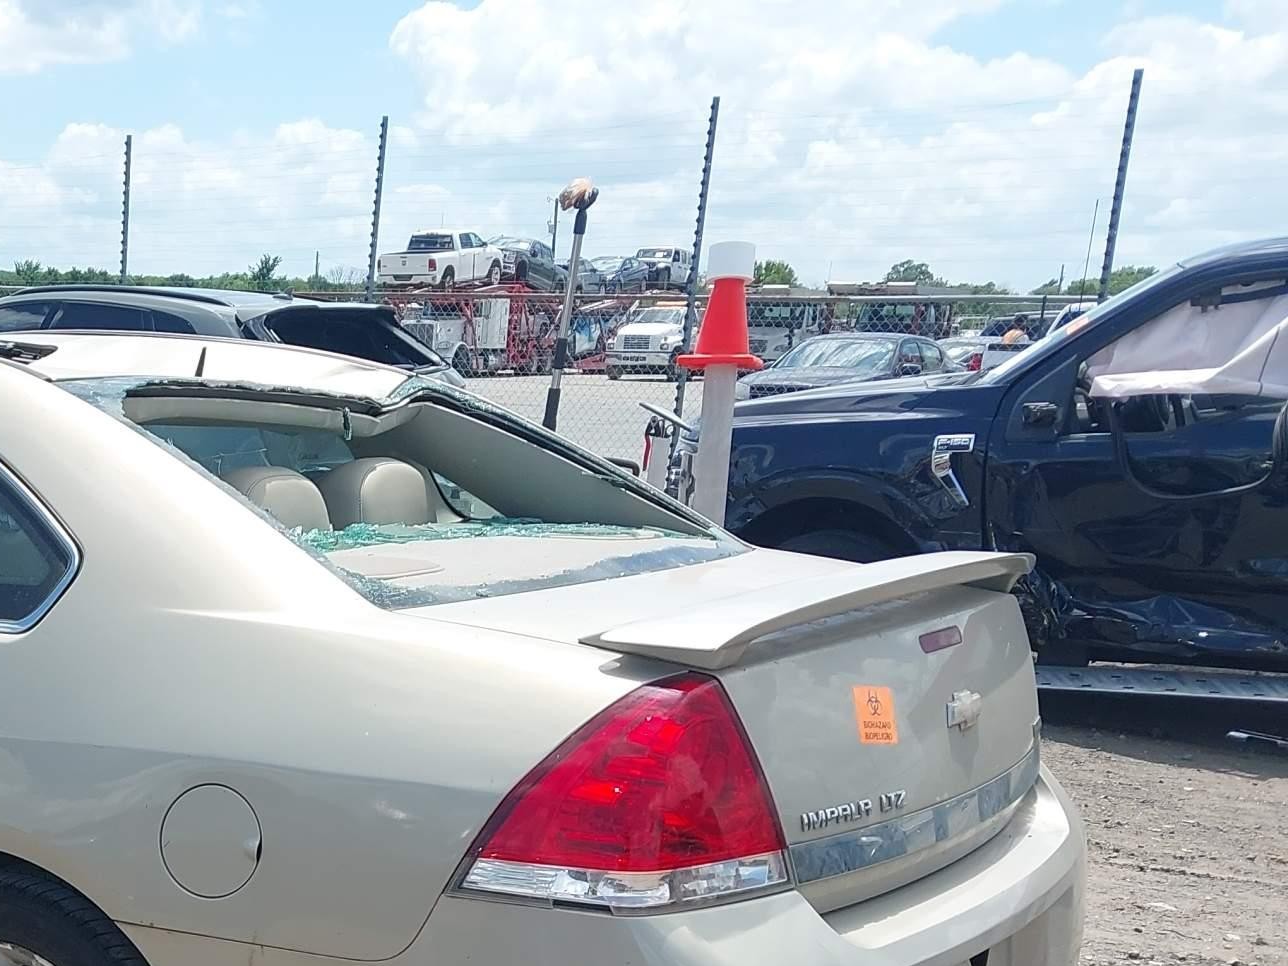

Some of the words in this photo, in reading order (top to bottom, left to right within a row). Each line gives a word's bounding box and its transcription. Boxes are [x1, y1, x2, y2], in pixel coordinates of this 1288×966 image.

[938, 438, 970, 446] F-150
[800, 799, 872, 832] IMPALA
[879, 789, 906, 813] LTZ
